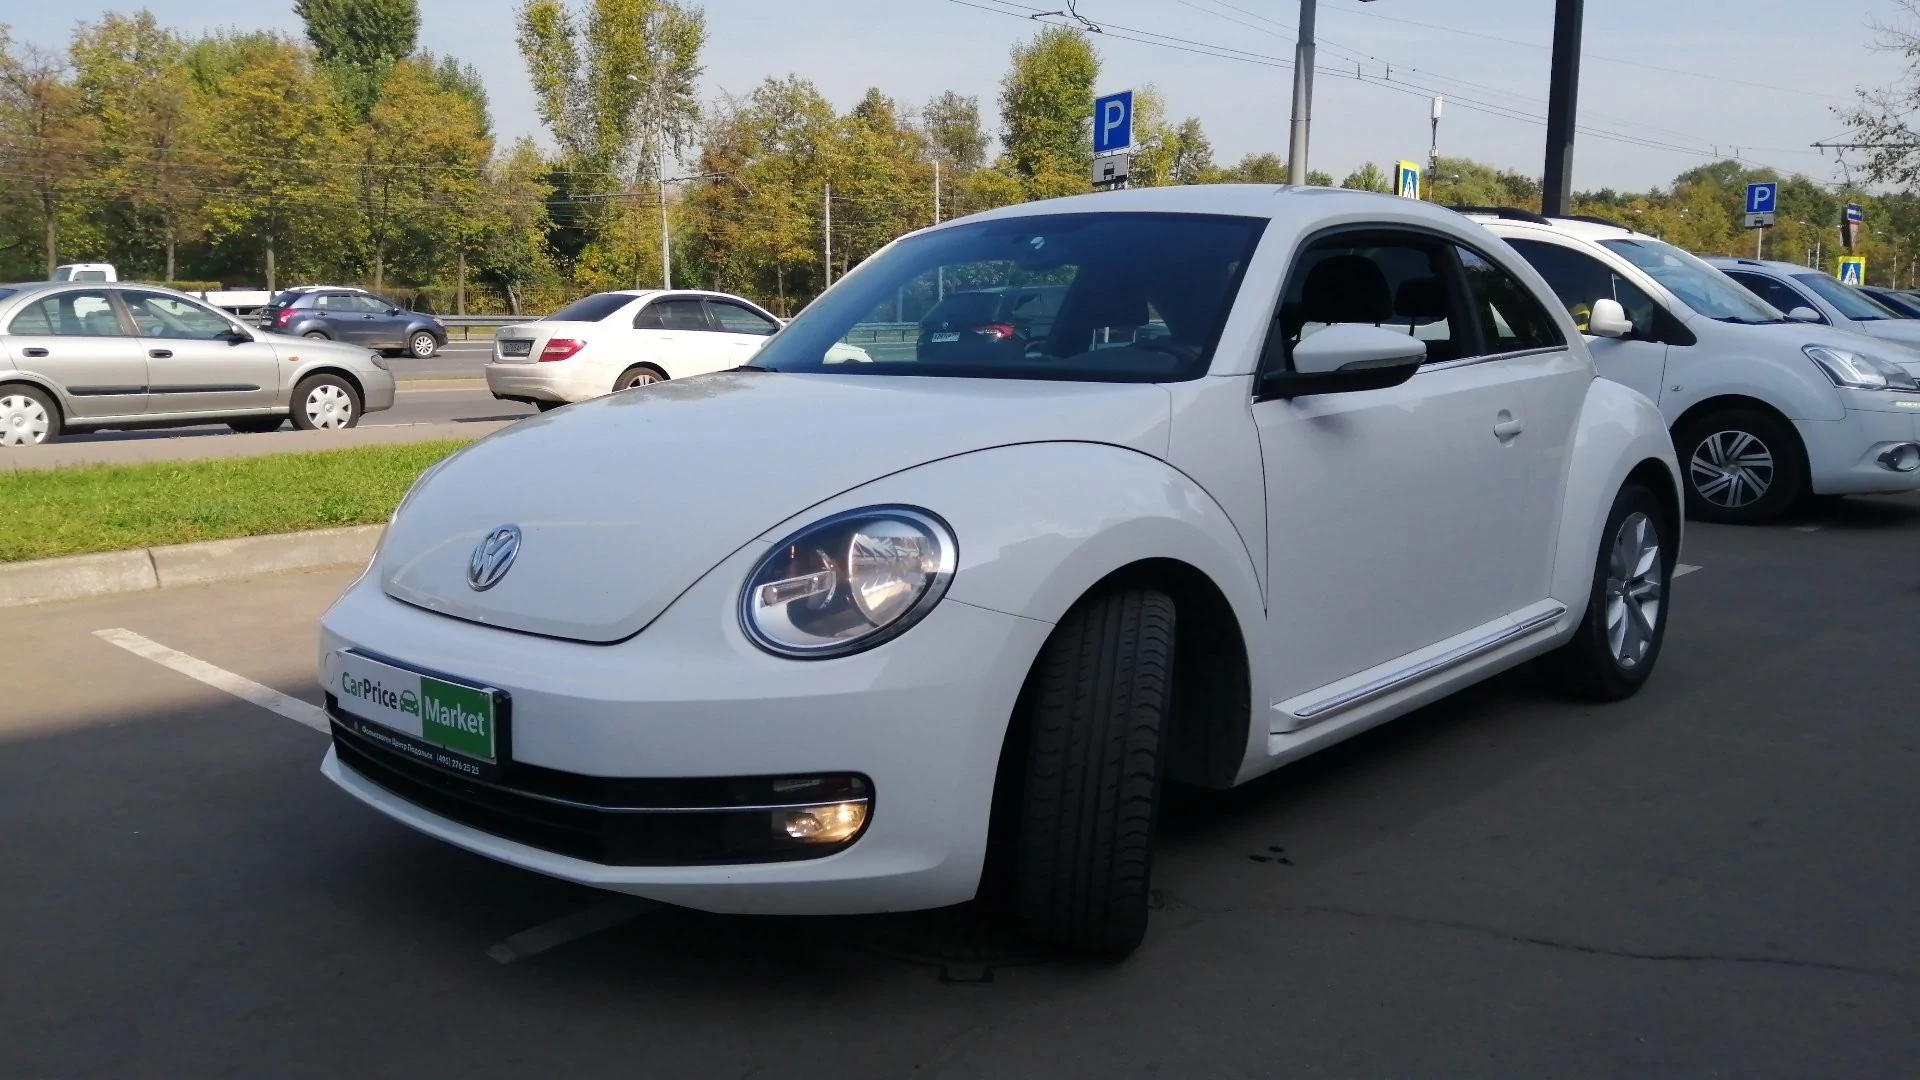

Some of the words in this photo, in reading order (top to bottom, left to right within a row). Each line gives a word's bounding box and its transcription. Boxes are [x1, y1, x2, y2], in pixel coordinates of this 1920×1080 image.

[1103, 99, 1125, 146] P
[1753, 186, 1771, 210] P
[341, 671, 398, 710] CarPrice
[424, 695, 486, 736] Market
[436, 752, 451, 767] (495)
[451, 759, 463, 770] 276
